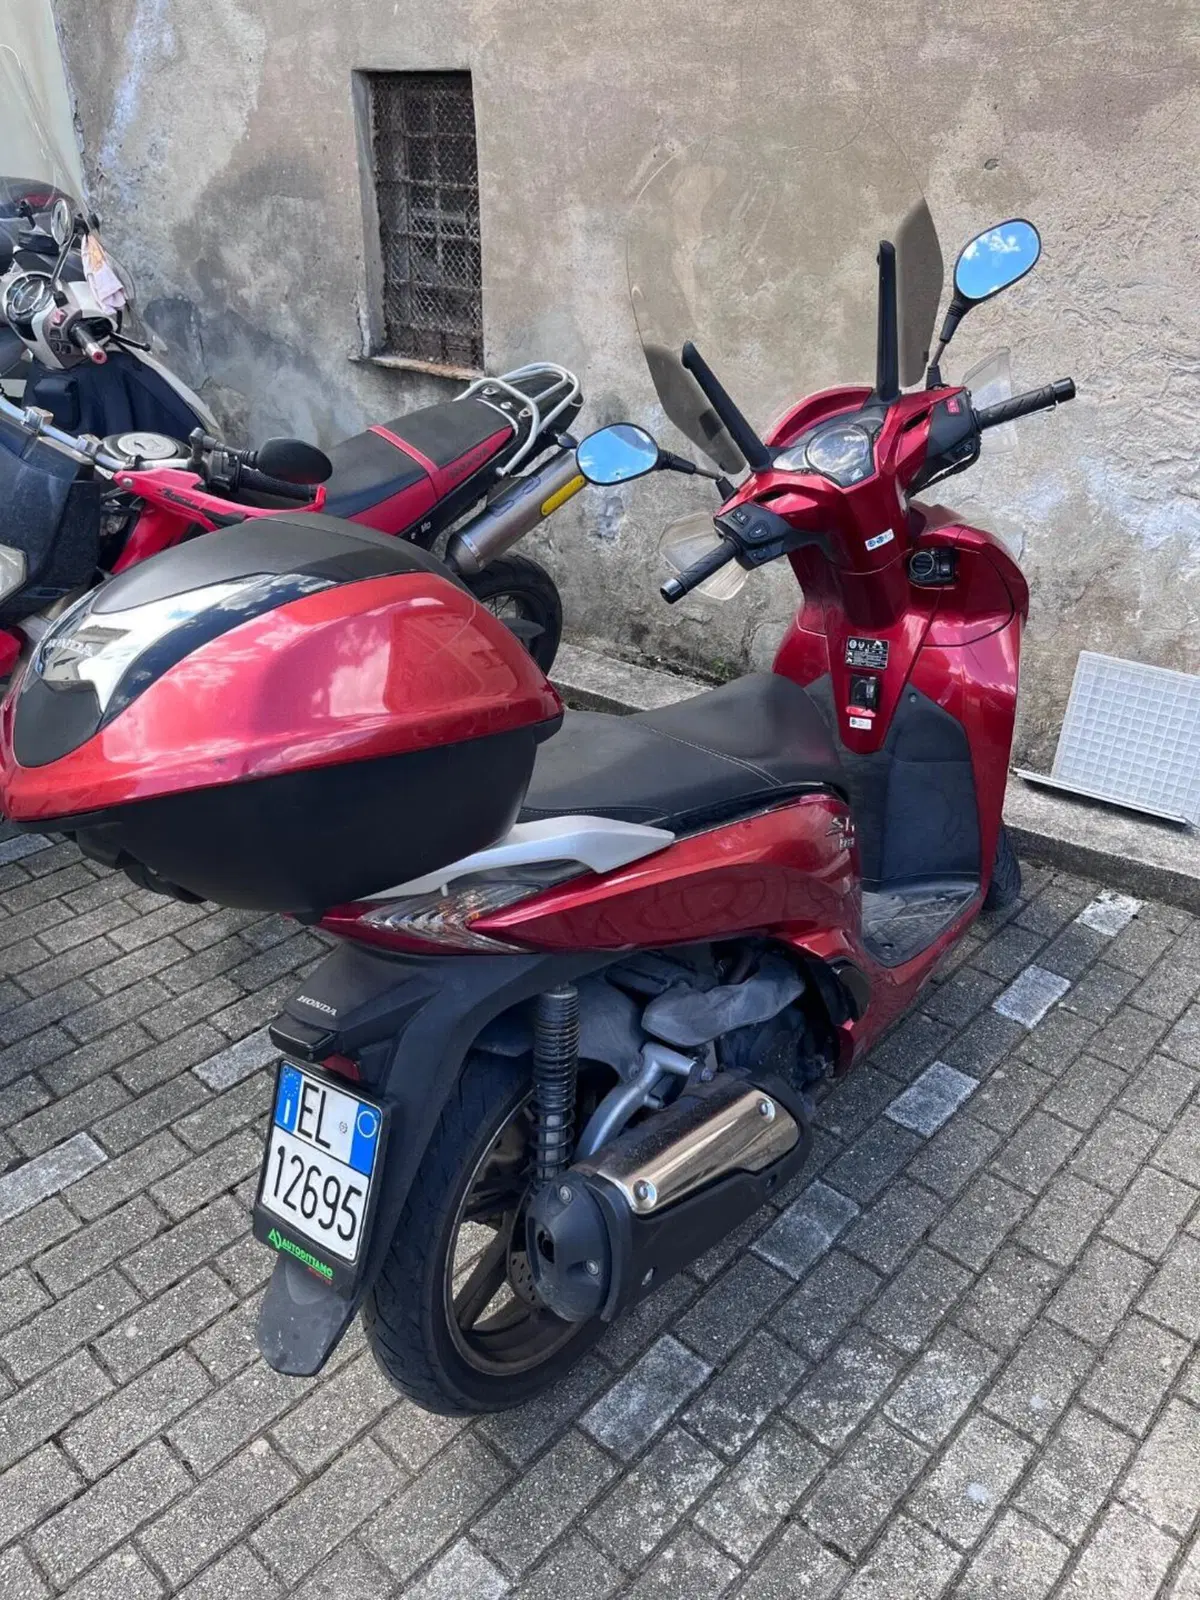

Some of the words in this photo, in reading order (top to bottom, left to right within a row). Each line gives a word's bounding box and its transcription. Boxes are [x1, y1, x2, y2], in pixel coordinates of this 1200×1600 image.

[296, 995, 338, 1016] HONDA
[297, 1079, 331, 1150] EL
[273, 1145, 362, 1241] 12695
[282, 1239, 333, 1277] AUTODITTAMO
